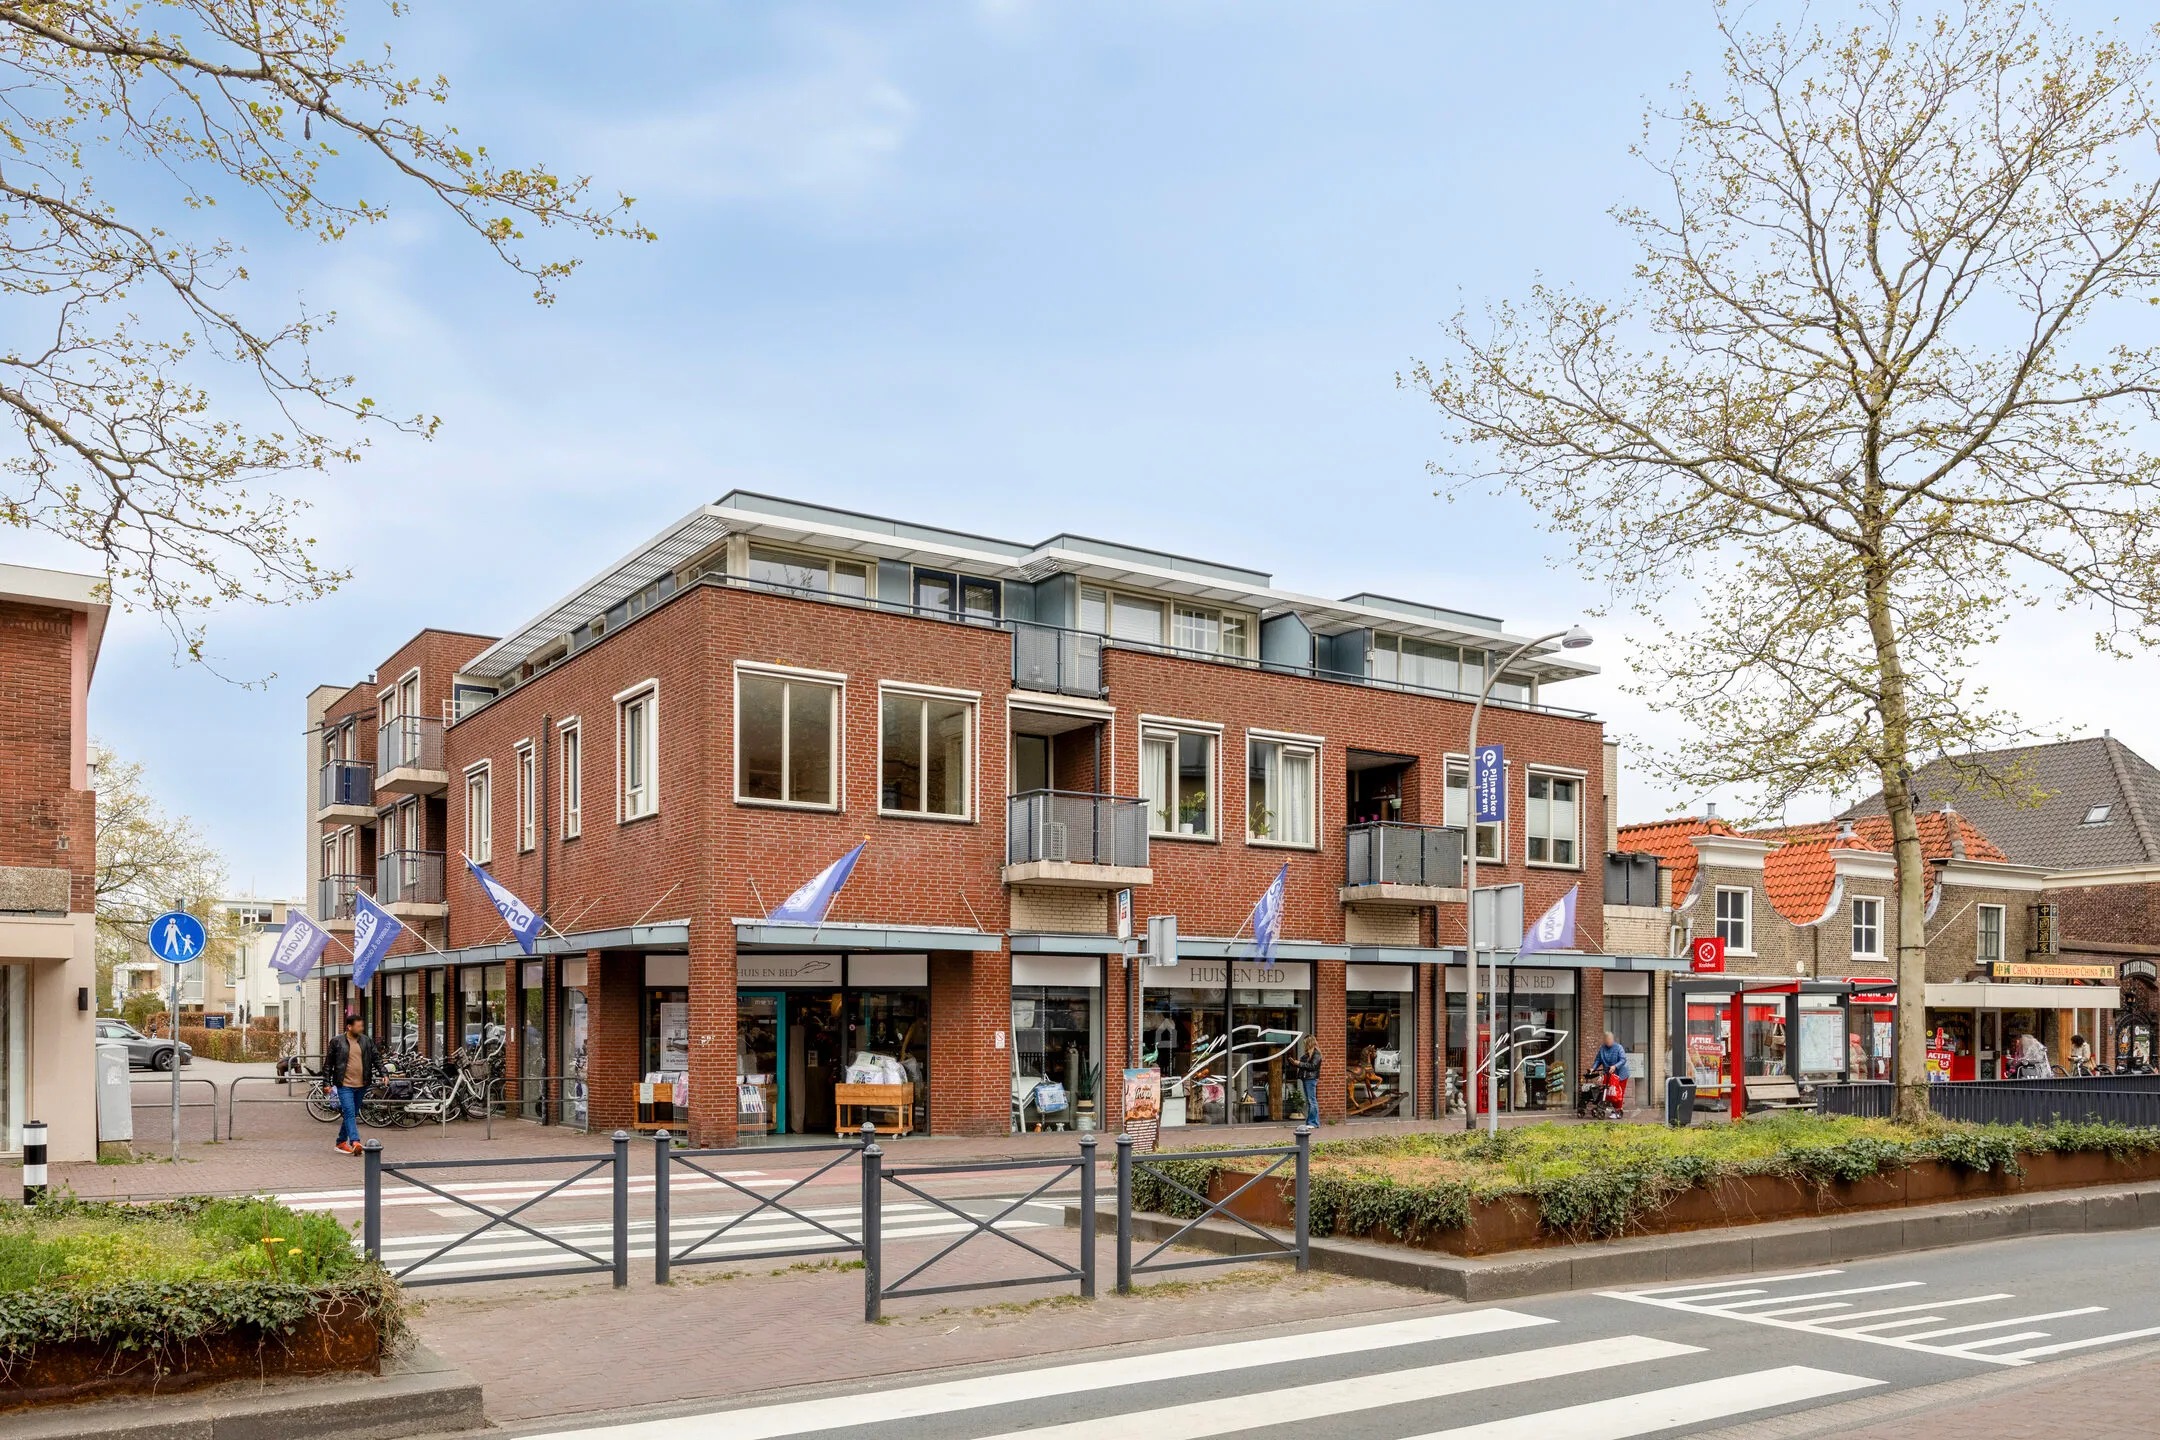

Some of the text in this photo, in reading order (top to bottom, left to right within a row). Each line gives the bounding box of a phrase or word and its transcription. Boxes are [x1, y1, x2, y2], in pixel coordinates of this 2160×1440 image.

[737, 968, 798, 977] HUIS EN BED
[1190, 967, 1285, 984] HUIS EN BED
[2044, 966, 2080, 977] RESTAURANT
[2081, 967, 2098, 977] CHINA
[1514, 975, 1529, 988] EN
[1533, 975, 1555, 989] BED
